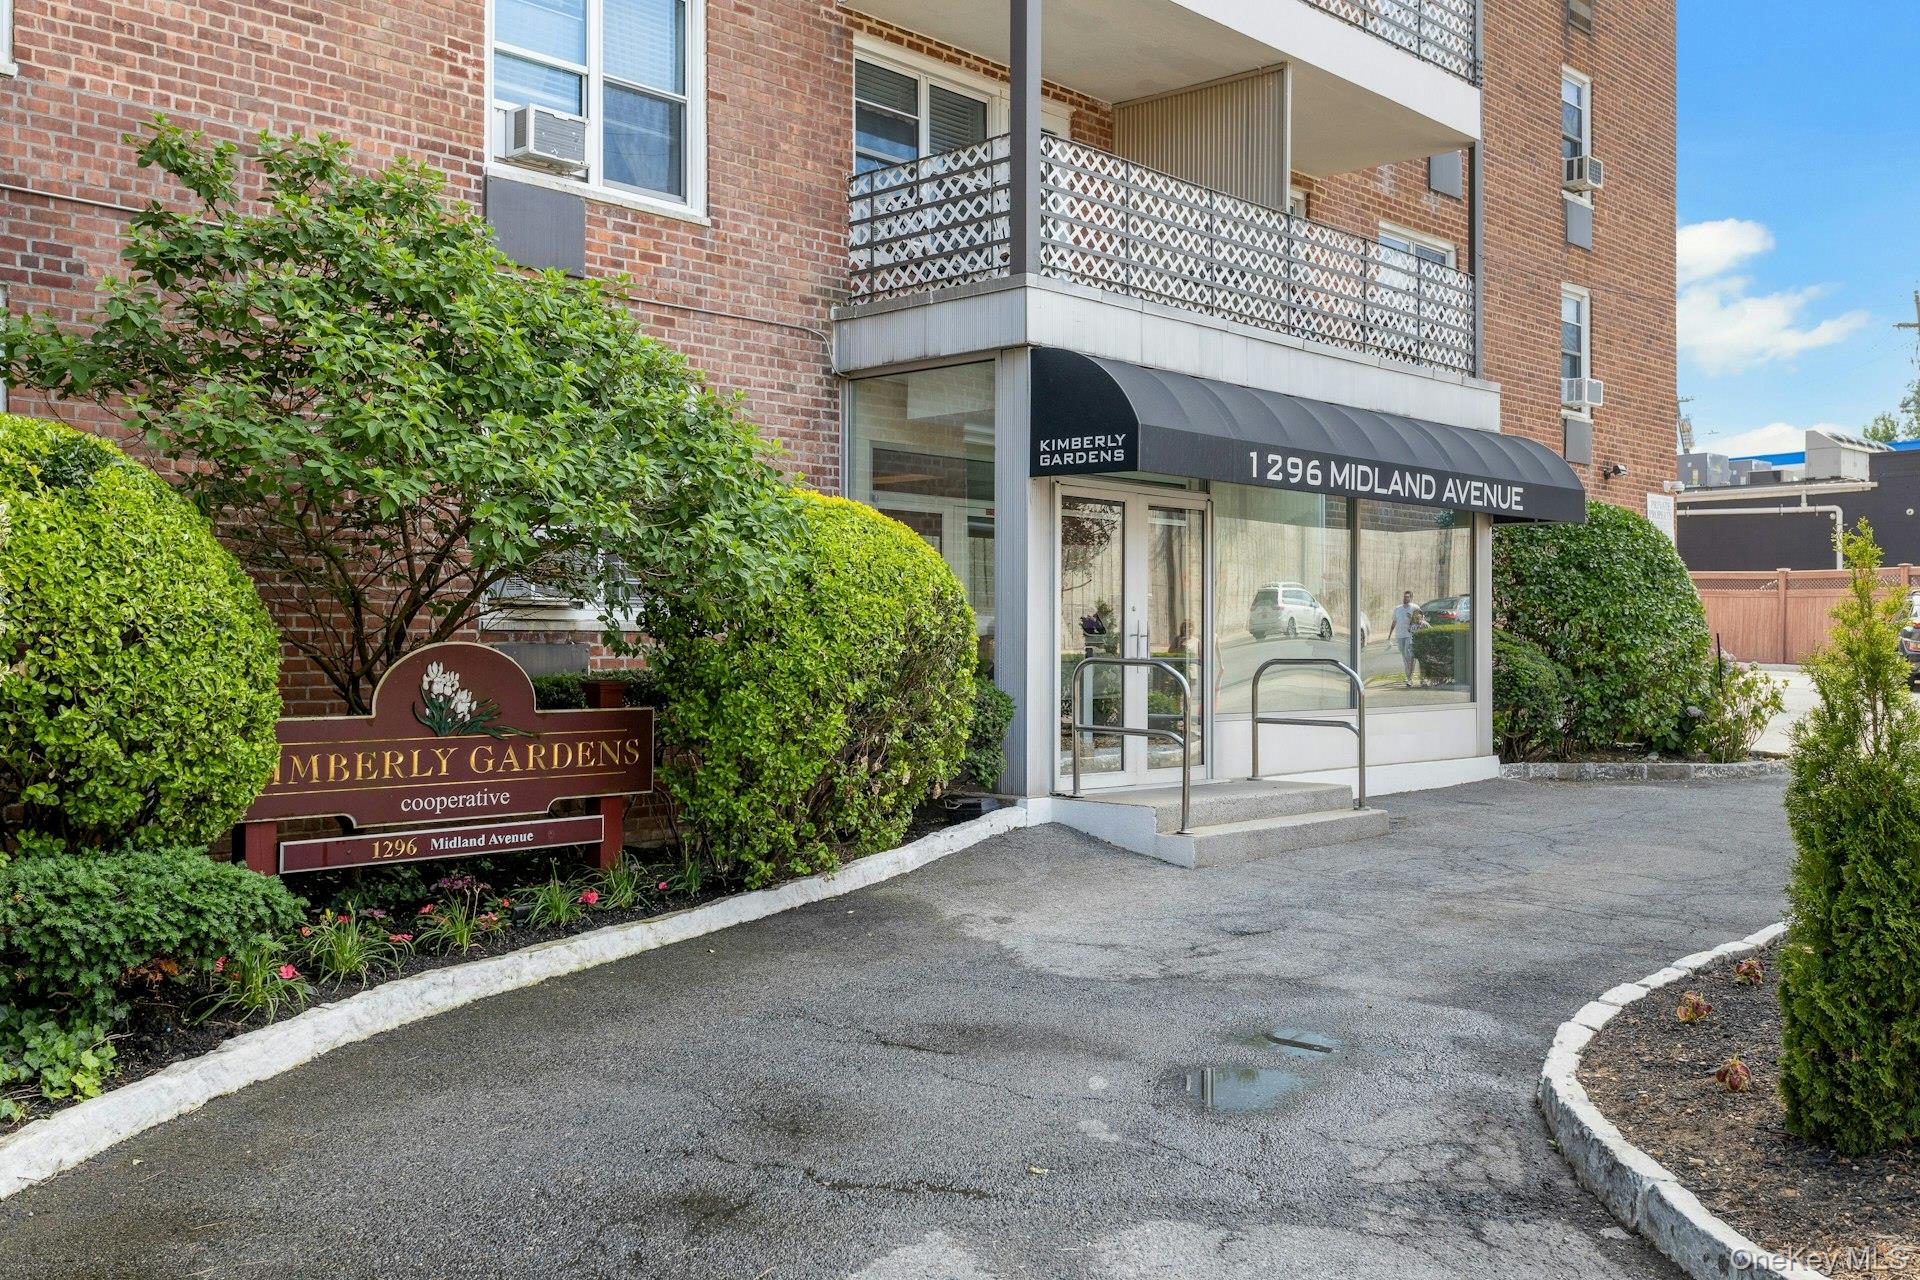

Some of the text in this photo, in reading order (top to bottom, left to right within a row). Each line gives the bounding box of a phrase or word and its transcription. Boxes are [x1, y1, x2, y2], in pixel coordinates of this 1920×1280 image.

[1039, 433, 1126, 452] KIMBERLY
[1039, 449, 1125, 467] GARDENS
[1249, 451, 1524, 511] 1296 MIDLAND AVENUE
[271, 738, 640, 785] IMBERLY GARDENS
[400, 788, 510, 814] cooperative
[371, 831, 534, 860] 1296 Midland Avenue
